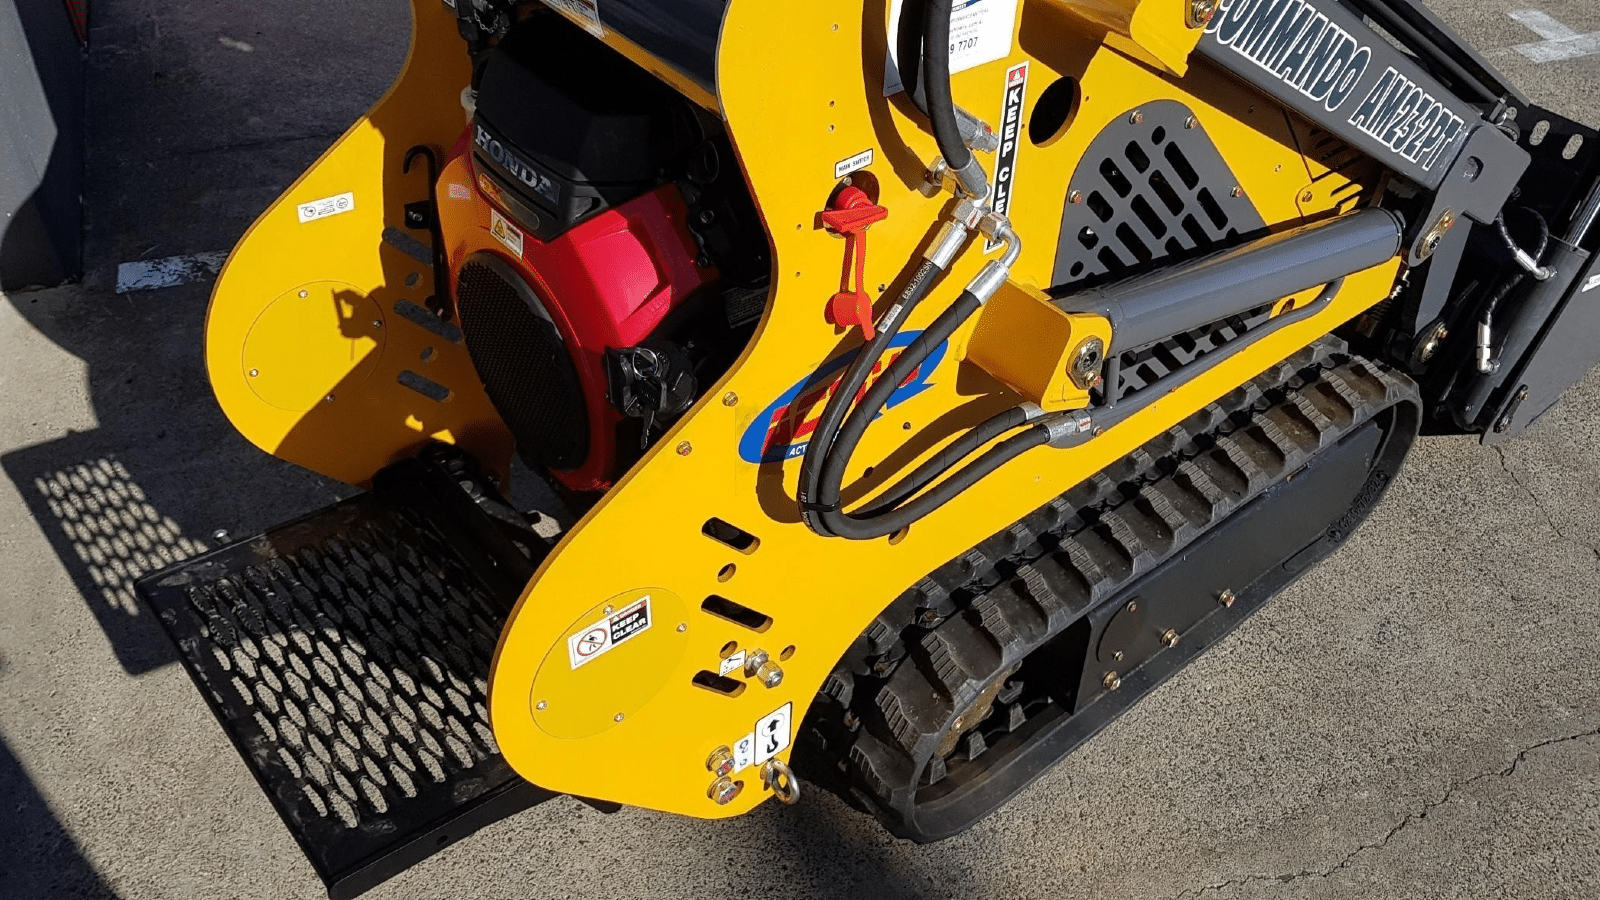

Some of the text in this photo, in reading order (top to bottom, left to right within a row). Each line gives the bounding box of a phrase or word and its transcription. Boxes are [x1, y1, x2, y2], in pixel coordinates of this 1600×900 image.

[958, 36, 979, 52] 7707
[1002, 87, 1020, 158] KEEP
[1348, 66, 1464, 171] AM232PT
[475, 125, 559, 204] HONDA
[612, 612, 640, 632] KEEP
[612, 617, 647, 640] CLEAR
